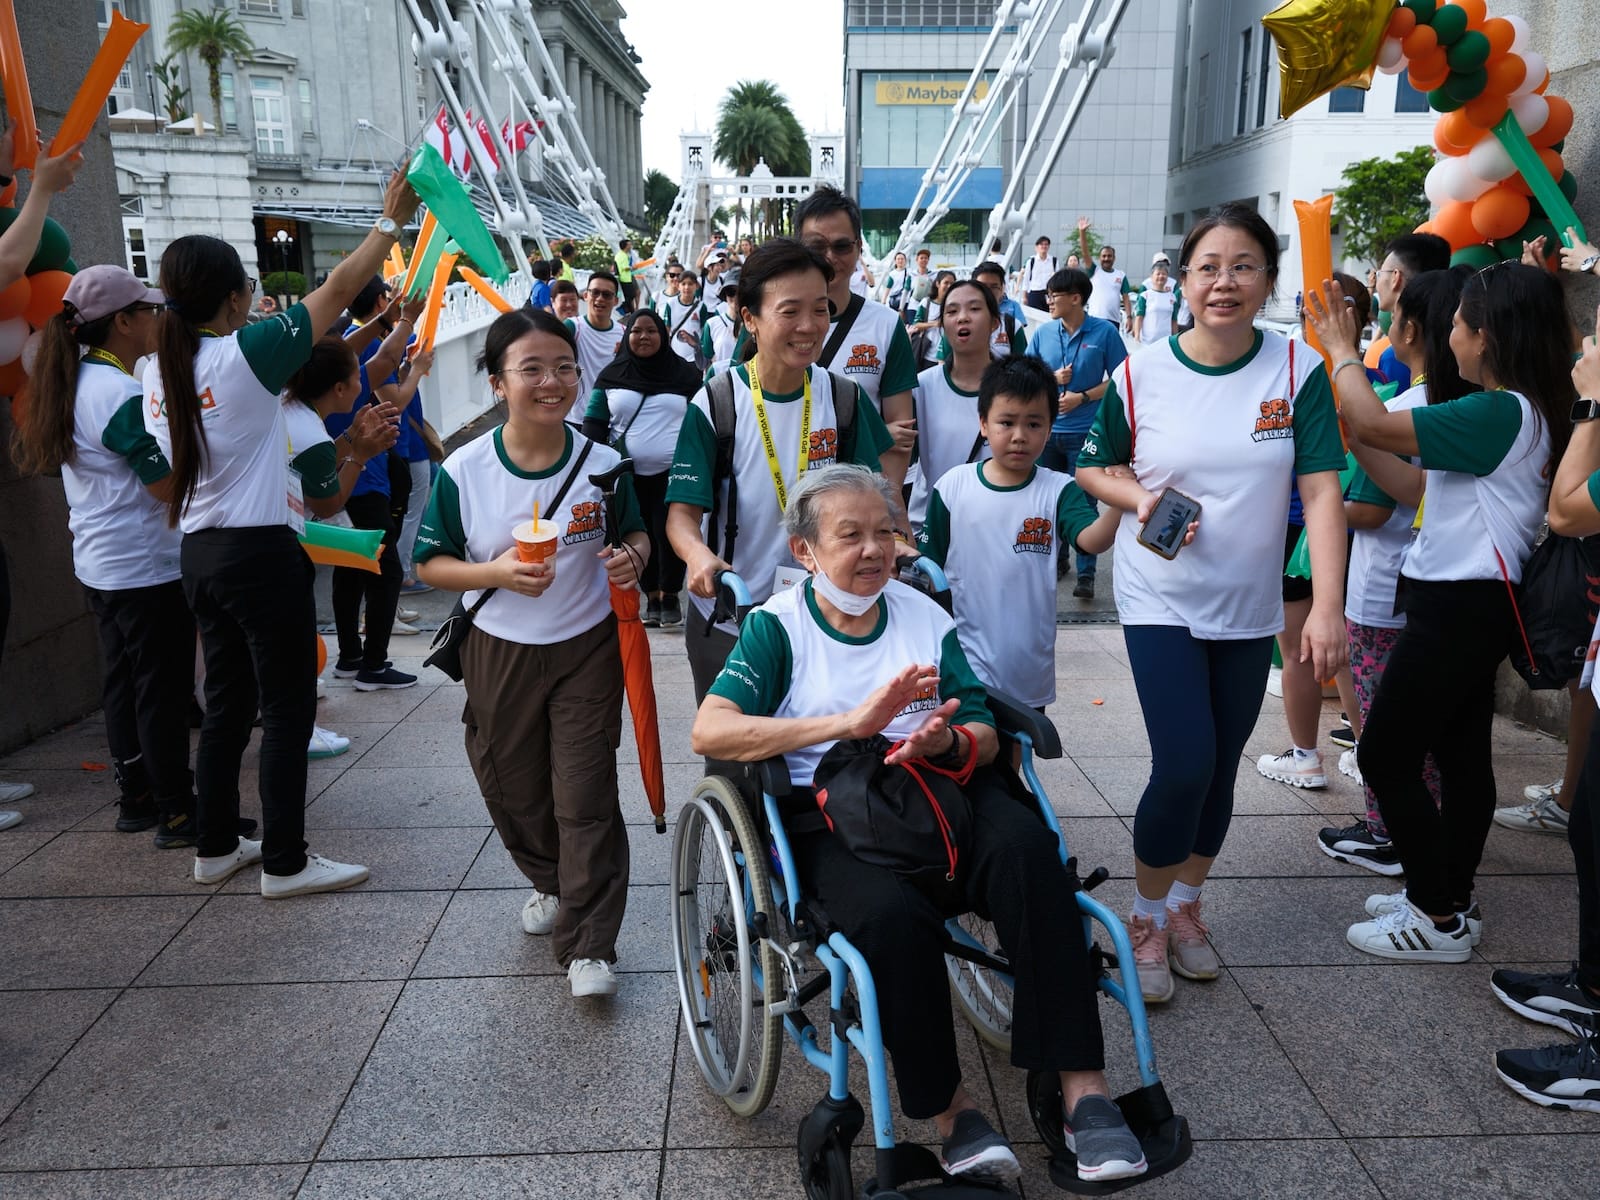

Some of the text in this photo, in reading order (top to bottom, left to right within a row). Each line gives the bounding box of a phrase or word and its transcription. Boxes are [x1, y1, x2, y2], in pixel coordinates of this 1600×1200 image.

[907, 86, 977, 102] Mayba
[852, 344, 878, 358] SPD
[802, 400, 810, 440] VOLUNTEER
[756, 404, 775, 459] SPD VOLUNTEER
[774, 471, 783, 486] SPD
[1024, 517, 1052, 533] SPD
